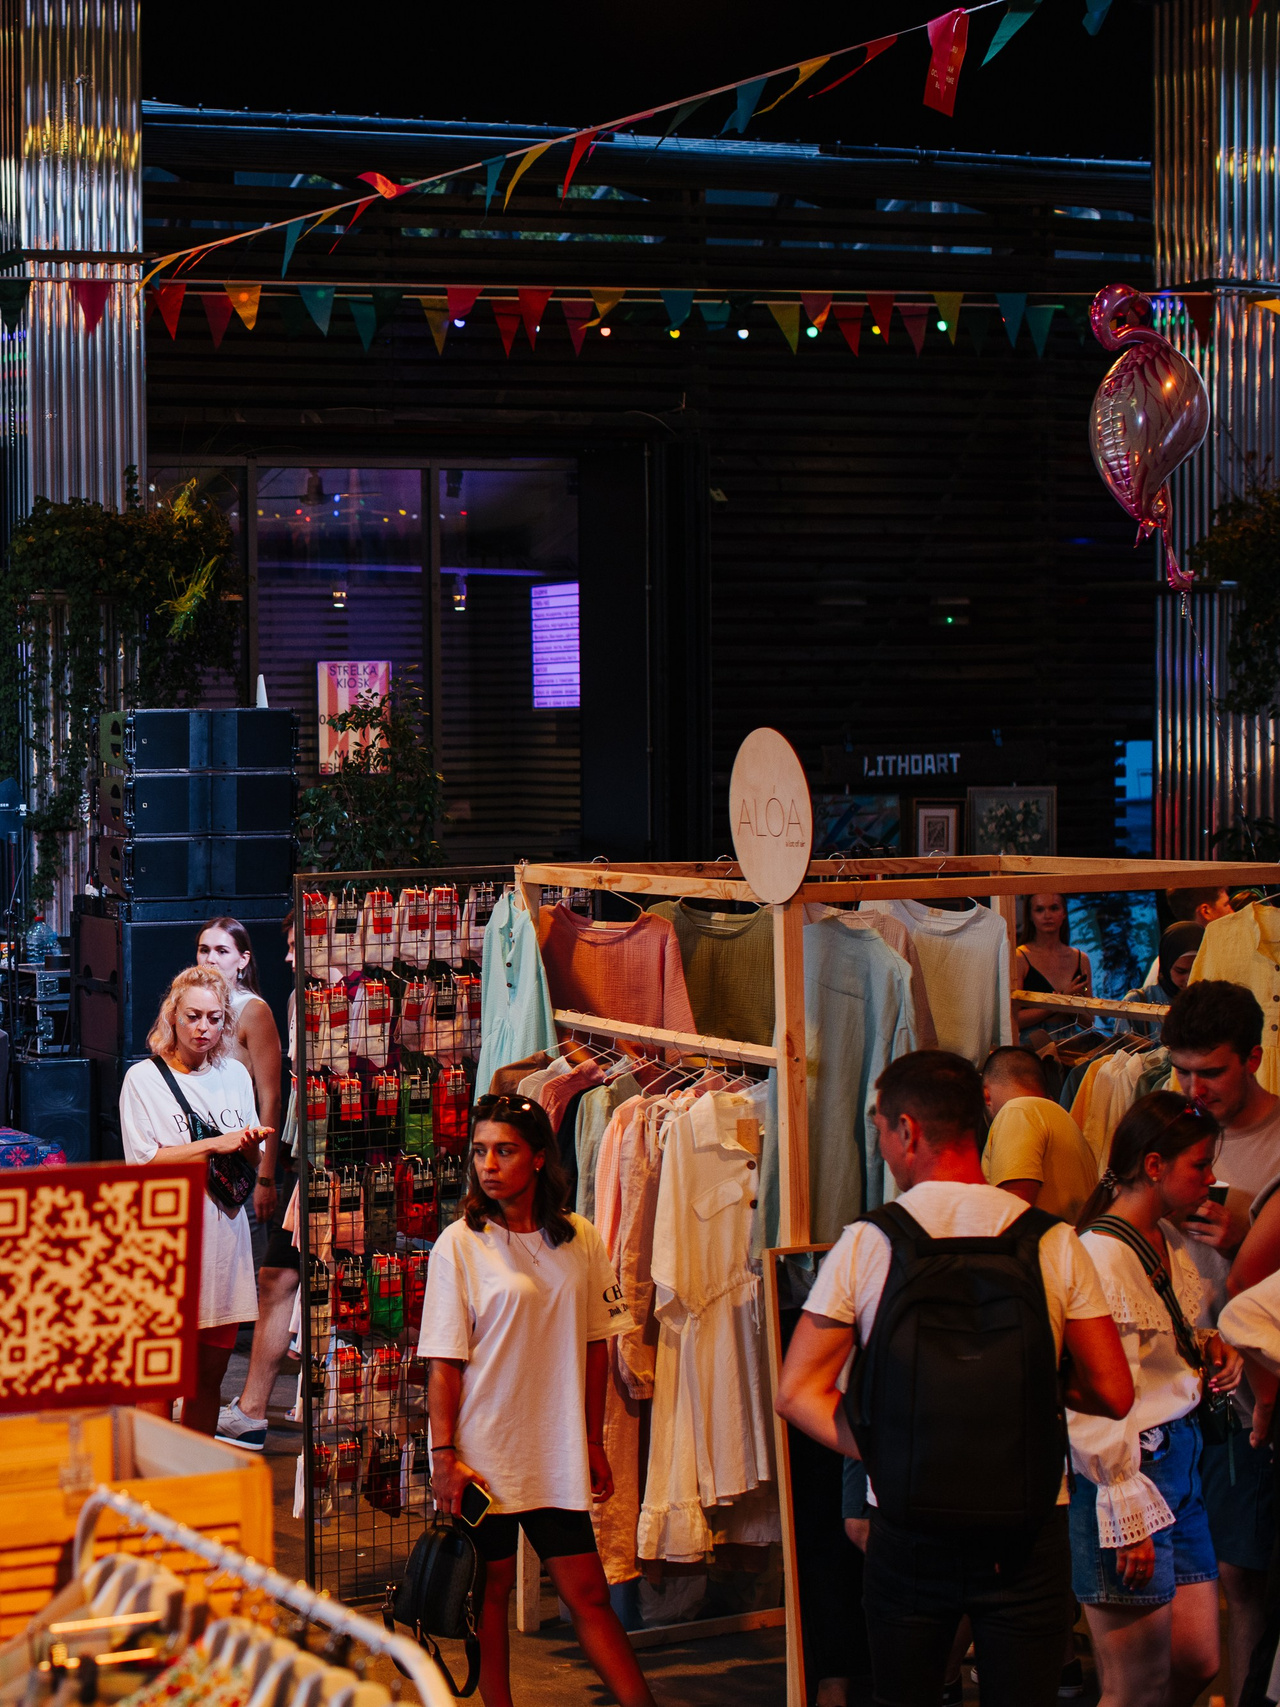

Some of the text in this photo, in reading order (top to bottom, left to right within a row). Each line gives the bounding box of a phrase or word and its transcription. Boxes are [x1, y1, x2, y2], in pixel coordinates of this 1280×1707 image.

[329, 665, 378, 676] STRELKA
[336, 678, 370, 689] KIOSK
[863, 753, 960, 777] LITHOART
